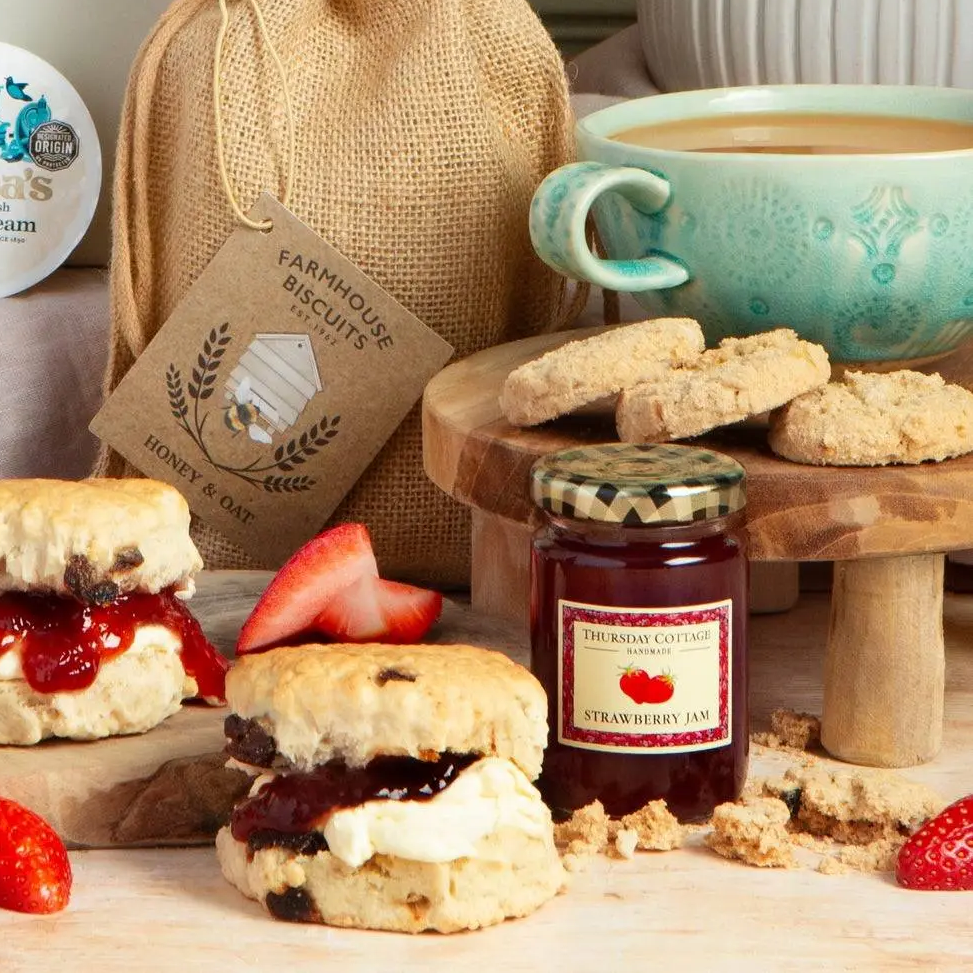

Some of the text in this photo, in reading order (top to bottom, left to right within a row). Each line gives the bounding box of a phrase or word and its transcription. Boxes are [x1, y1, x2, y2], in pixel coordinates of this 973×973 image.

[35, 139, 73, 154] ORIGIN
[278, 249, 395, 352] FARMHOUSE
[281, 275, 370, 351] BISCUITS
[143, 434, 256, 524] HONEY & OAT
[582, 629, 711, 645] THURSDAY COTTAGE
[627, 647, 672, 655] HANDMADE
[584, 710, 710, 726] STRAWBERRY JAM
